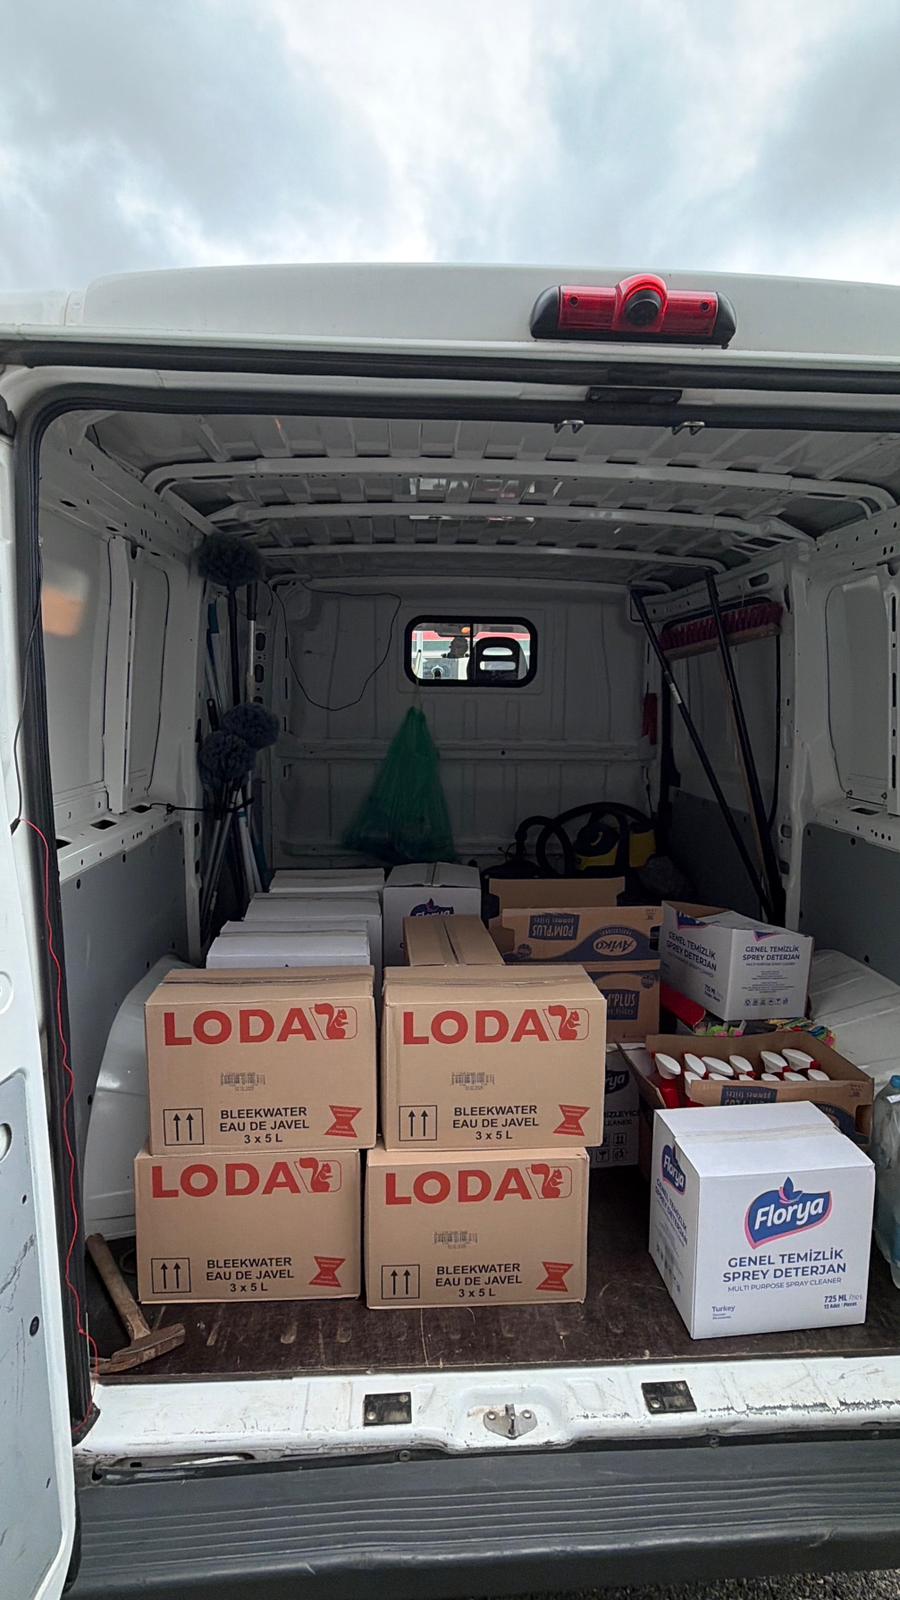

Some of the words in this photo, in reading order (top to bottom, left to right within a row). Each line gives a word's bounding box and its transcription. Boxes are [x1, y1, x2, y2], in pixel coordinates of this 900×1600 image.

[532, 924, 574, 937] POM'PLUS
[596, 940, 634, 952] Aviko
[770, 944, 800, 952] TEMİZLİK
[163, 1007, 317, 1046] LODA
[402, 1008, 550, 1045] LODA
[220, 1106, 308, 1120] BLEEKWATER
[454, 1105, 538, 1116] BLEEKWATER
[219, 1121, 246, 1132] EAU
[250, 1121, 266, 1131] DE
[270, 1119, 310, 1130] JAVEL
[452, 1118, 478, 1128] EAU
[482, 1118, 498, 1128] DE
[501, 1117, 540, 1127] JAVEL
[244, 1134, 251, 1144] 3
[254, 1136, 261, 1144] x
[265, 1133, 272, 1143] 5
[275, 1133, 283, 1142] L
[476, 1130, 482, 1140] 3
[486, 1132, 492, 1140] x
[496, 1130, 502, 1140] 5
[506, 1130, 513, 1139] L
[151, 1161, 301, 1199] LODA
[385, 1167, 532, 1205] LODA
[754, 1198, 824, 1230] Florya
[207, 1257, 292, 1269] BLEEKWATER
[728, 1255, 775, 1268] GENEL
[779, 1246, 844, 1264] TEMİZLİK
[206, 1271, 232, 1281] EAU
[236, 1270, 252, 1280] DE
[256, 1269, 294, 1280] JAVEL
[436, 1263, 520, 1275] BLEEKWATER
[722, 1269, 770, 1282] SPREY
[774, 1263, 846, 1279] DETERJAN
[230, 1283, 236, 1292] 3
[240, 1284, 246, 1292] x
[250, 1282, 257, 1292] 5
[261, 1282, 268, 1292] L
[435, 1277, 461, 1287] EAU
[464, 1277, 481, 1286] DE
[484, 1275, 522, 1285] JAVEL
[809, 1278, 842, 1286] CLEANER
[458, 1288, 465, 1297] 3
[479, 1288, 485, 1297] 5
[489, 1288, 496, 1297] L
[824, 1295, 837, 1303] 725
